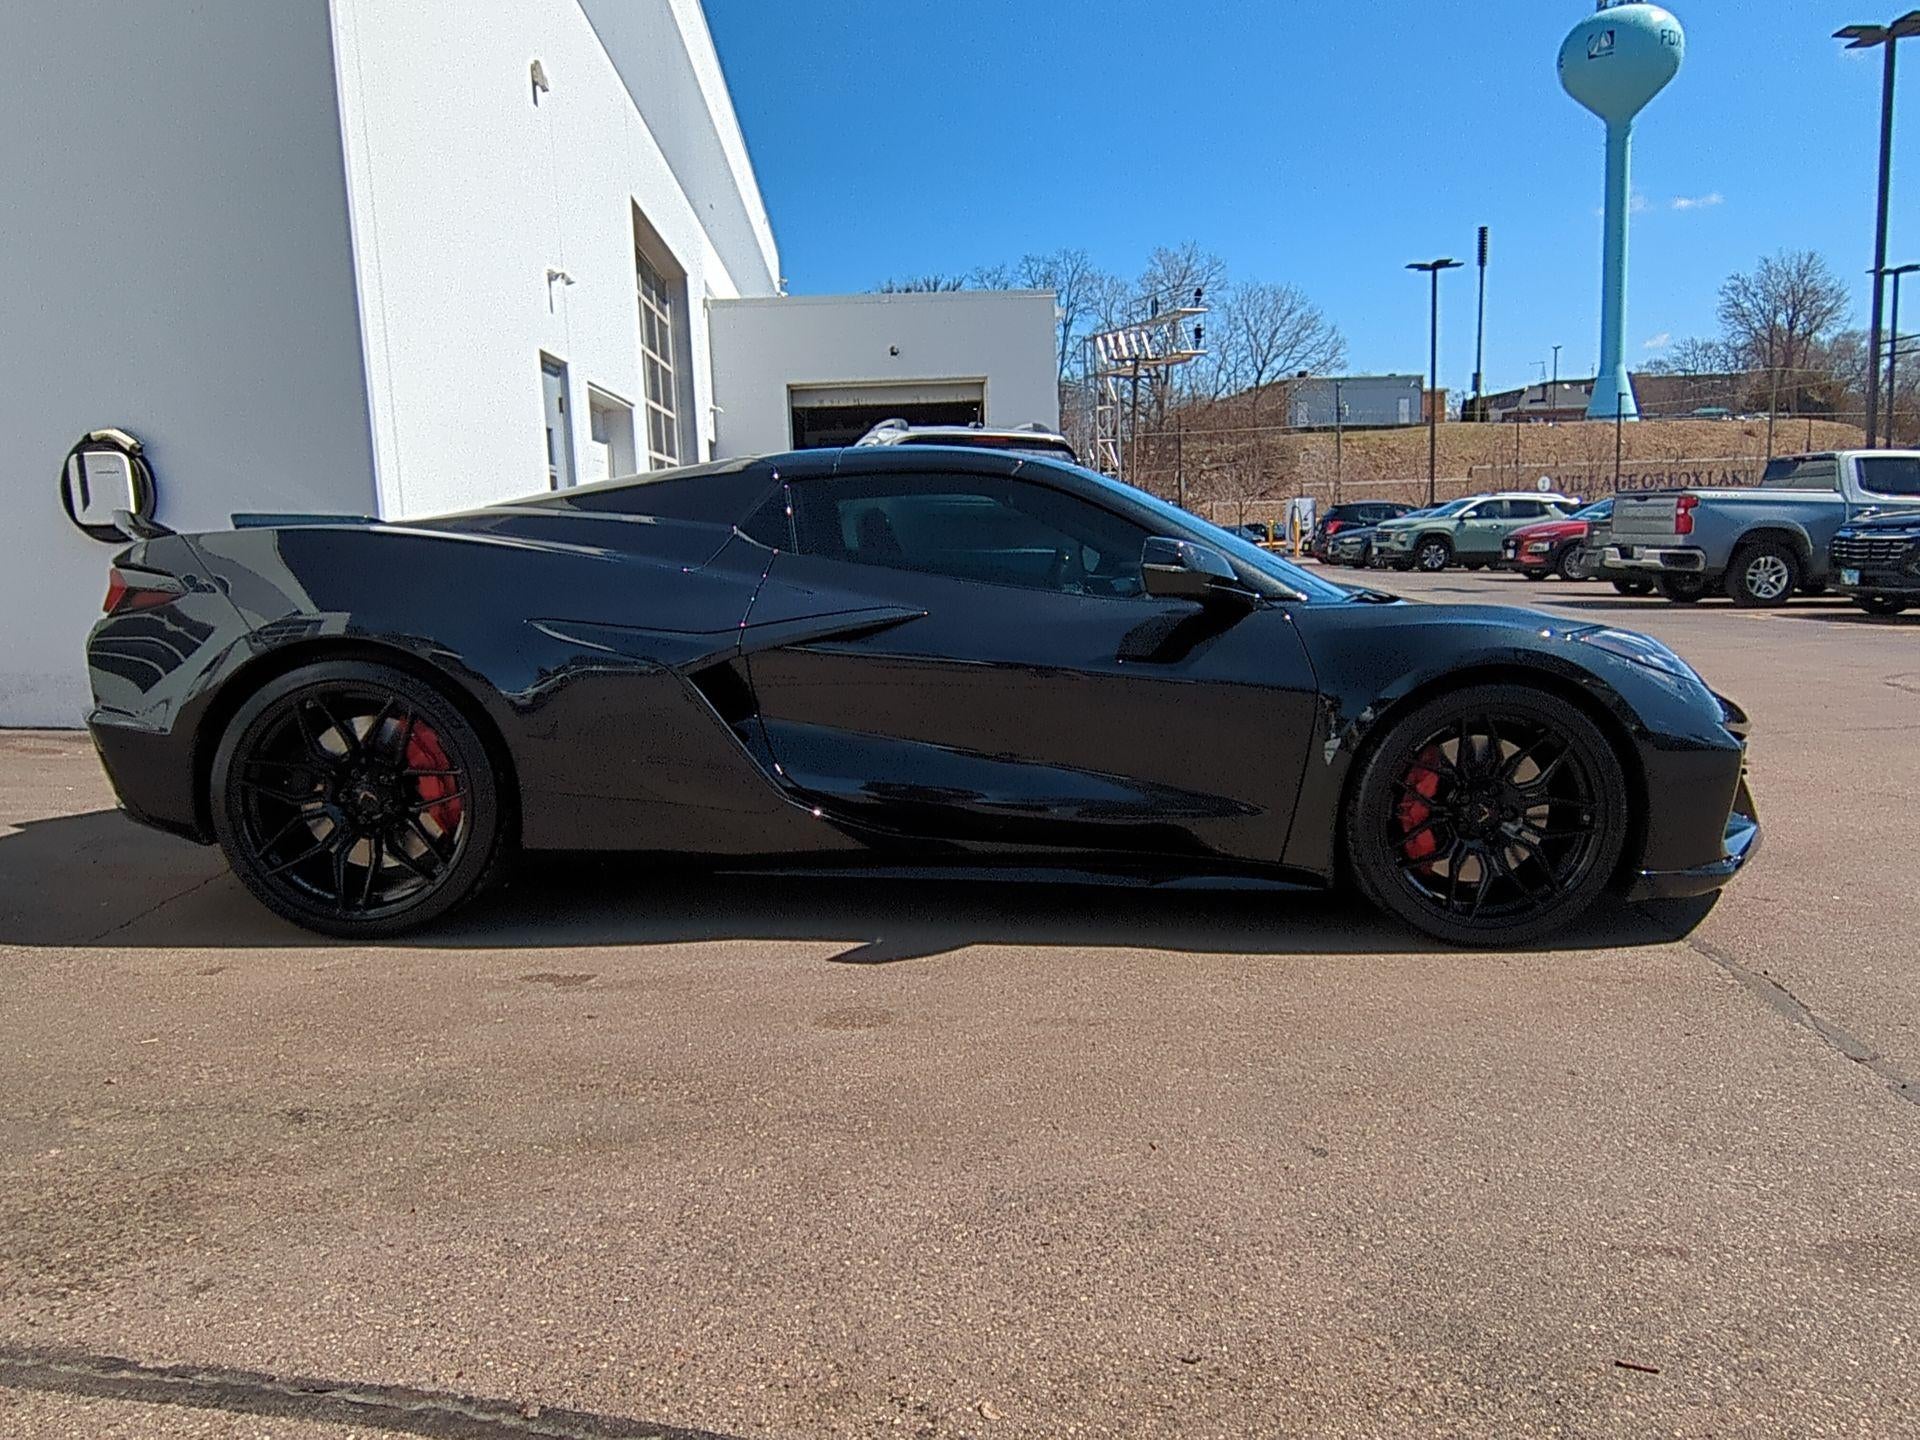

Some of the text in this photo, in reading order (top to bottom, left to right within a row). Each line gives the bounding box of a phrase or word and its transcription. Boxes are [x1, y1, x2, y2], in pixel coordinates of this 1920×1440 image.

[1660, 29, 1682, 48] FOX
[1641, 471, 1666, 489] OF
[1668, 470, 1704, 488] FOX
[1706, 468, 1756, 487] LAKE
